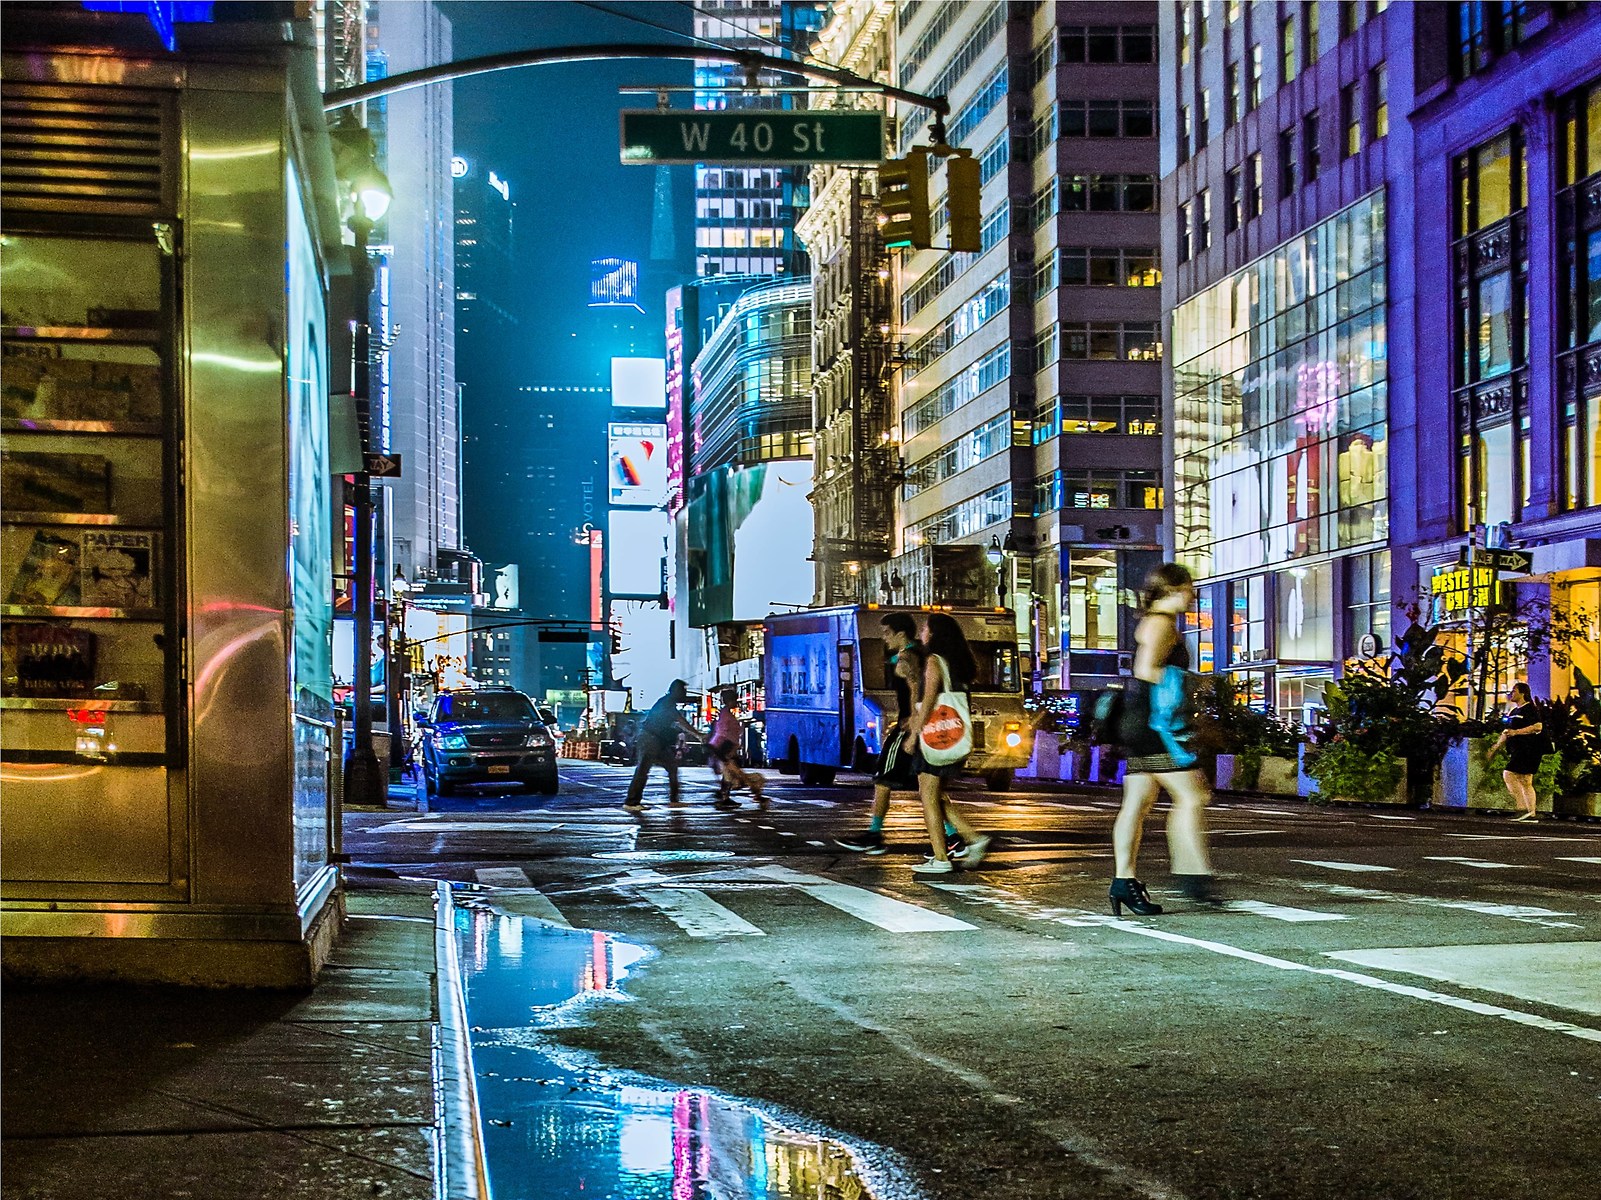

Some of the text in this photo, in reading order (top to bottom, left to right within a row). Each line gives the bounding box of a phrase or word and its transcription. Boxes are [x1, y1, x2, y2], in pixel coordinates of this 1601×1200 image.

[680, 121, 826, 154] W 40 St
[83, 533, 150, 547] PAPER
[1500, 555, 1521, 567] WAY
